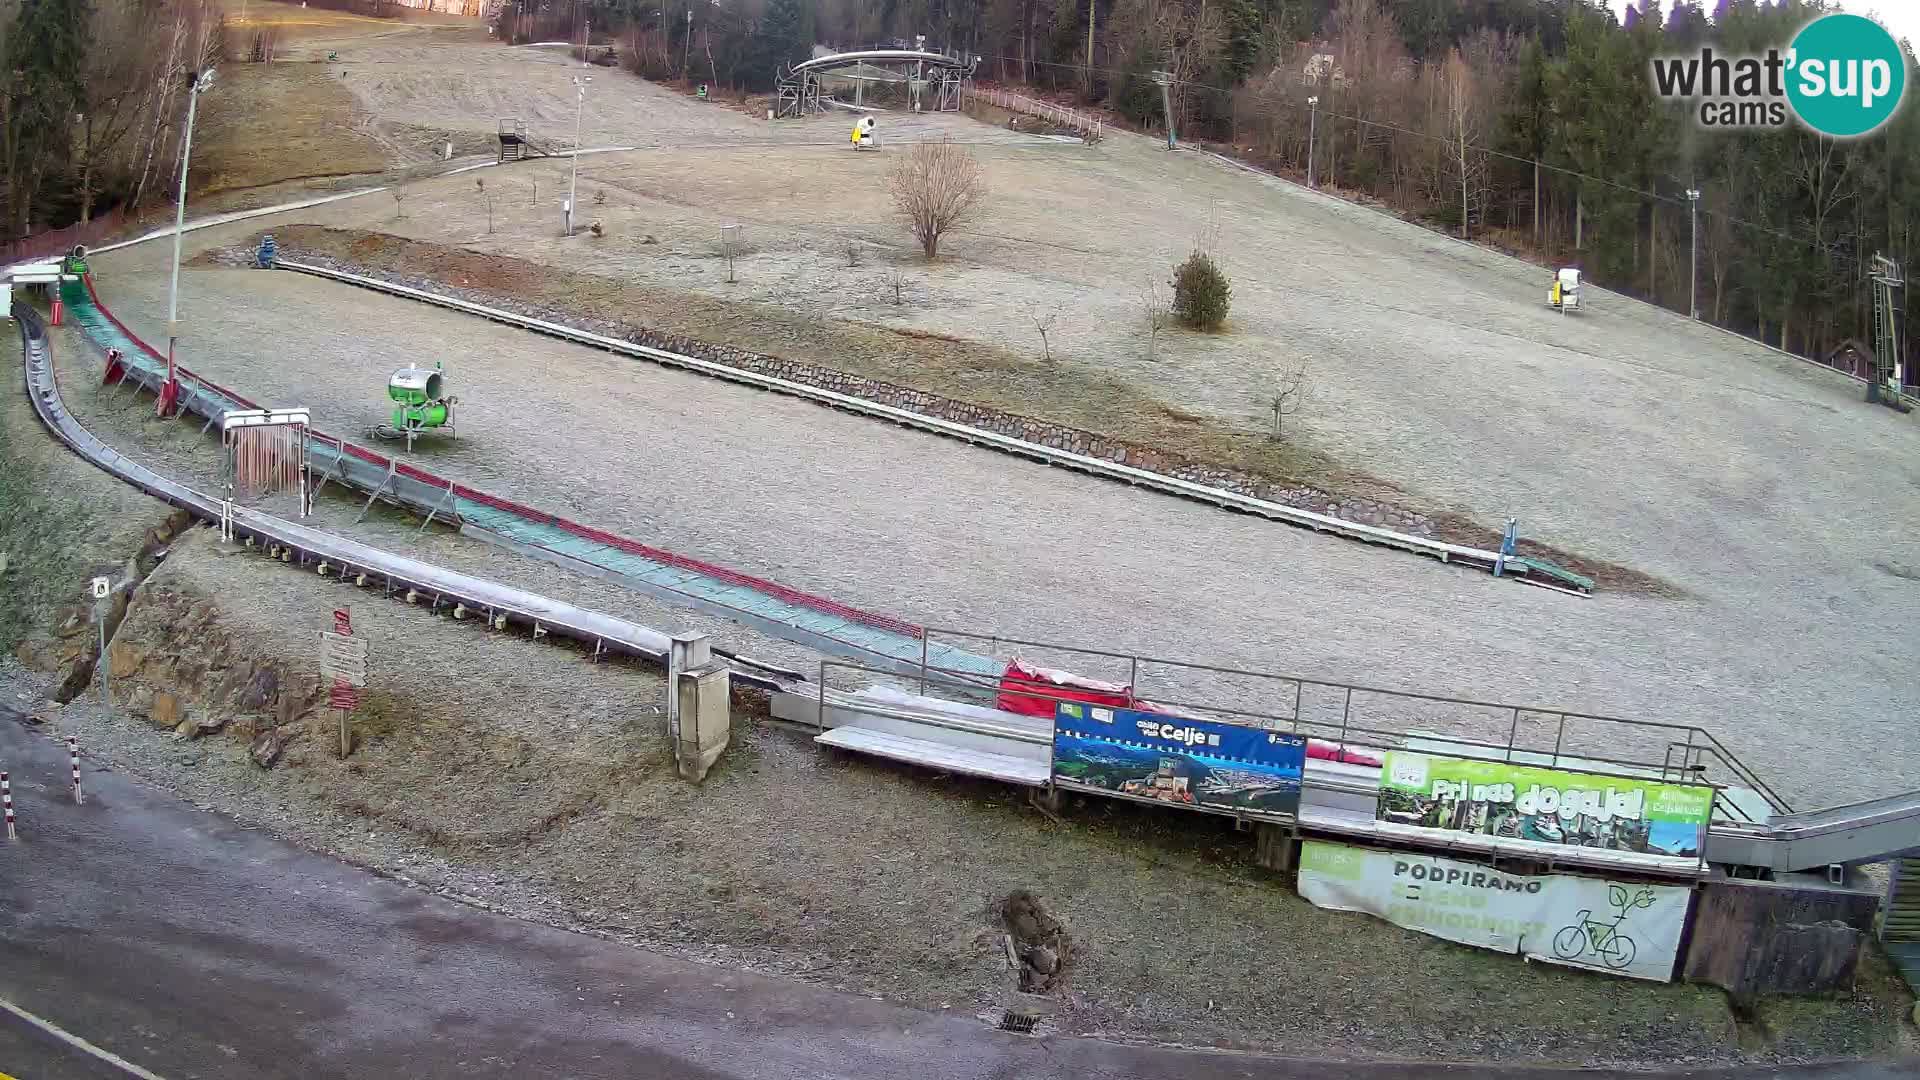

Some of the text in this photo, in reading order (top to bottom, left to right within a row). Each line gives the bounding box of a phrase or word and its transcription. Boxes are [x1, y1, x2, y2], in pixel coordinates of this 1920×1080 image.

[1160, 724, 1206, 746] Celje
[1431, 778, 1468, 801] Pri
[1473, 782, 1515, 803] nas
[1394, 861, 1542, 894] PODPIRAMO
